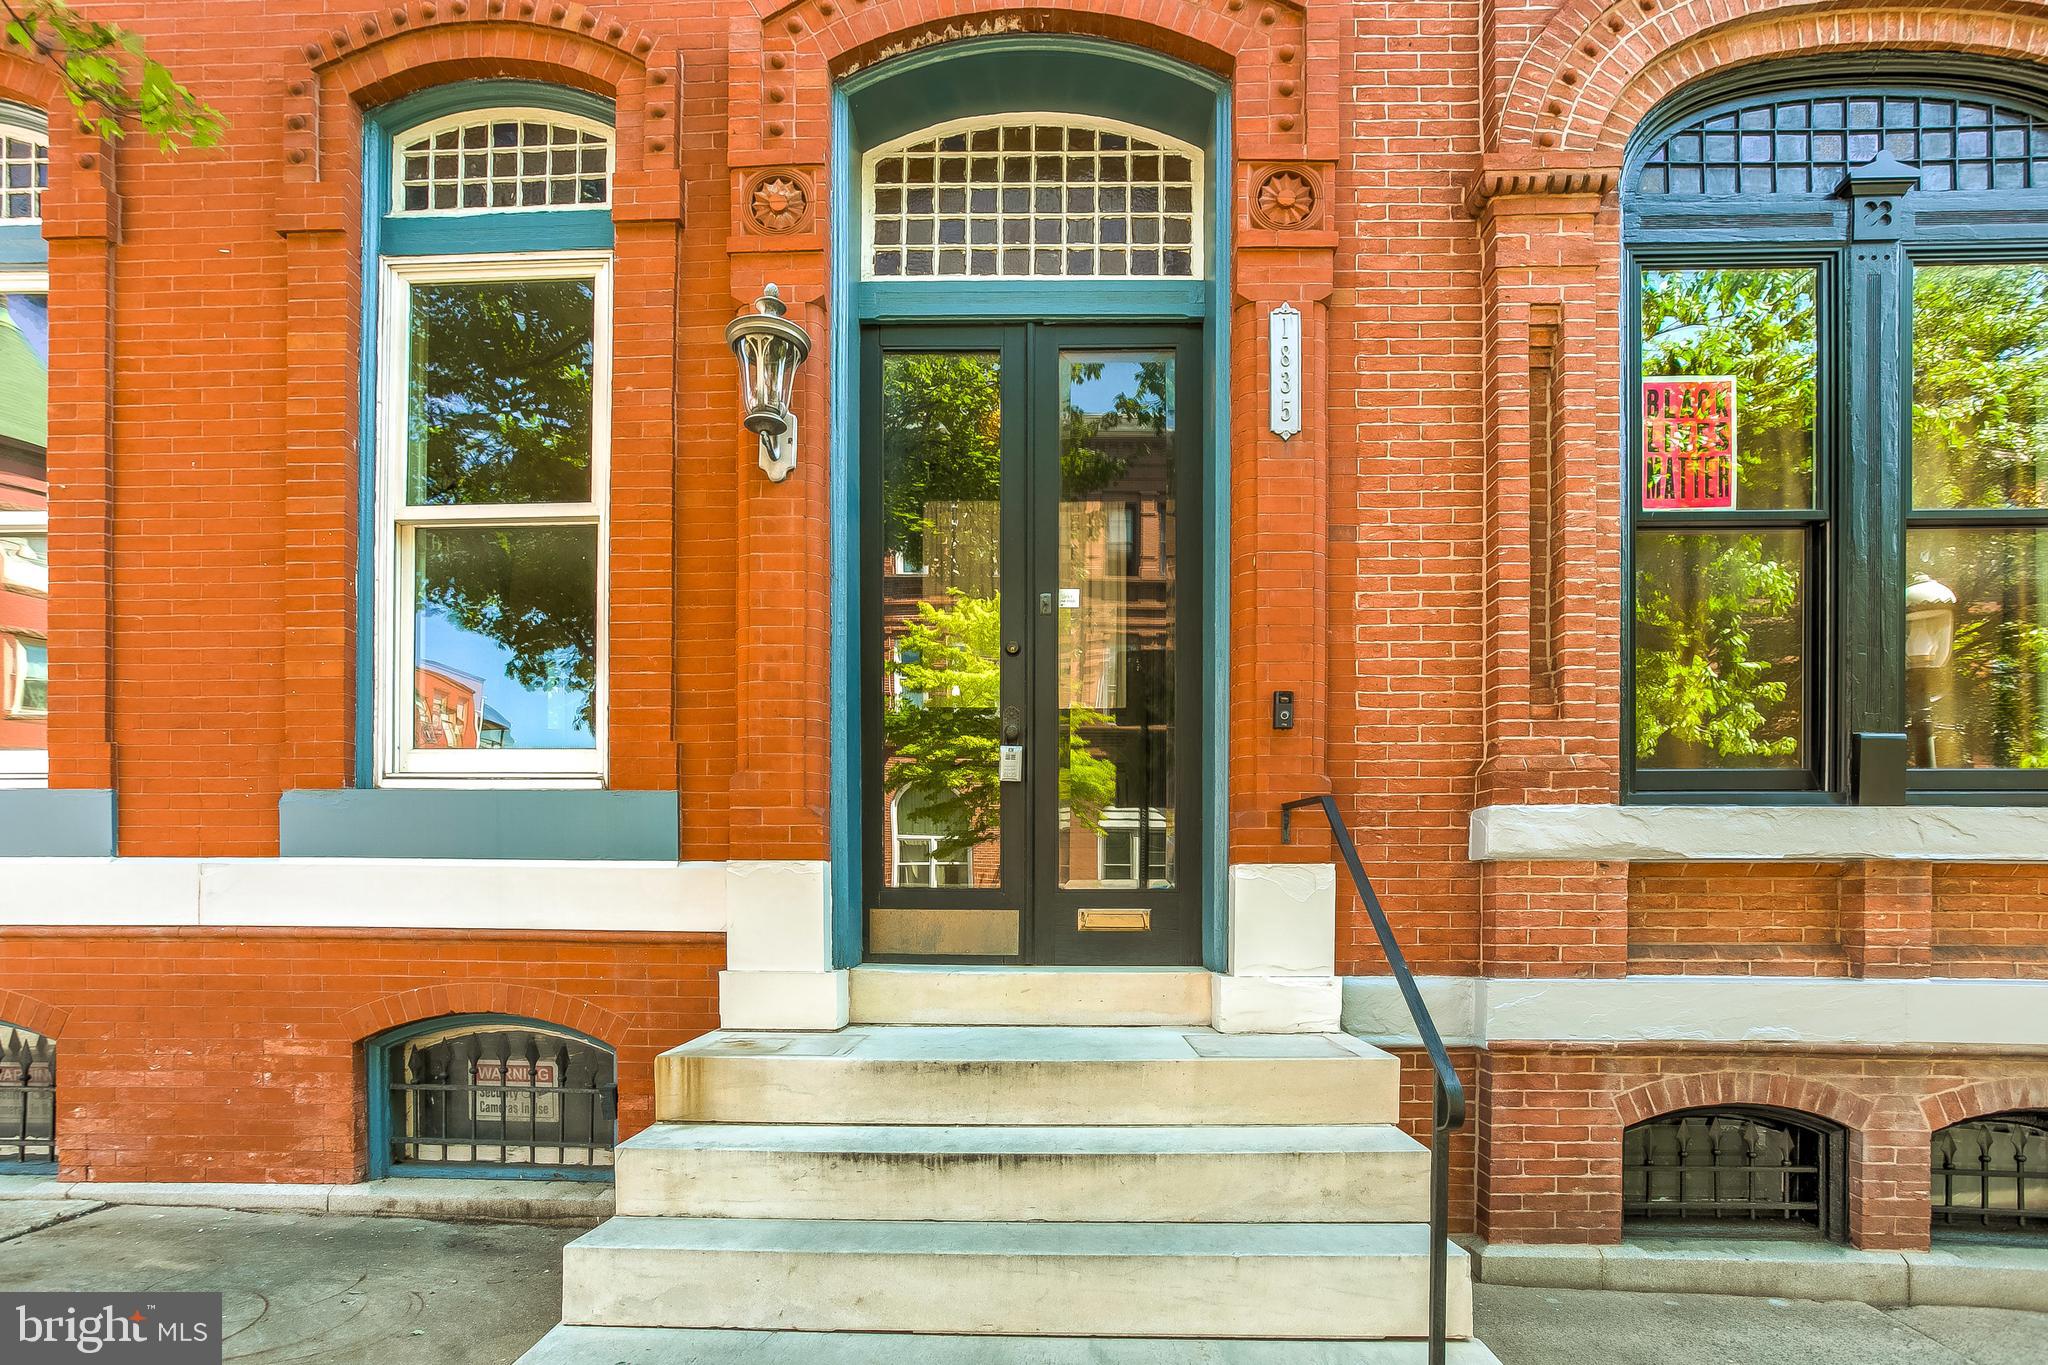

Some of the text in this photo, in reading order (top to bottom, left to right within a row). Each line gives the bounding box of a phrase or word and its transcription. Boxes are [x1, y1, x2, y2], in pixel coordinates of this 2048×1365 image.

[1280, 318, 1292, 422] 1835
[1646, 389, 1729, 419] BLACK
[1646, 422, 1730, 453] LIVES
[1646, 456, 1730, 499] MATTER
[478, 1066, 549, 1081] WARNIG
[479, 1101, 518, 1114] Cameas
[534, 1103, 549, 1114] se
